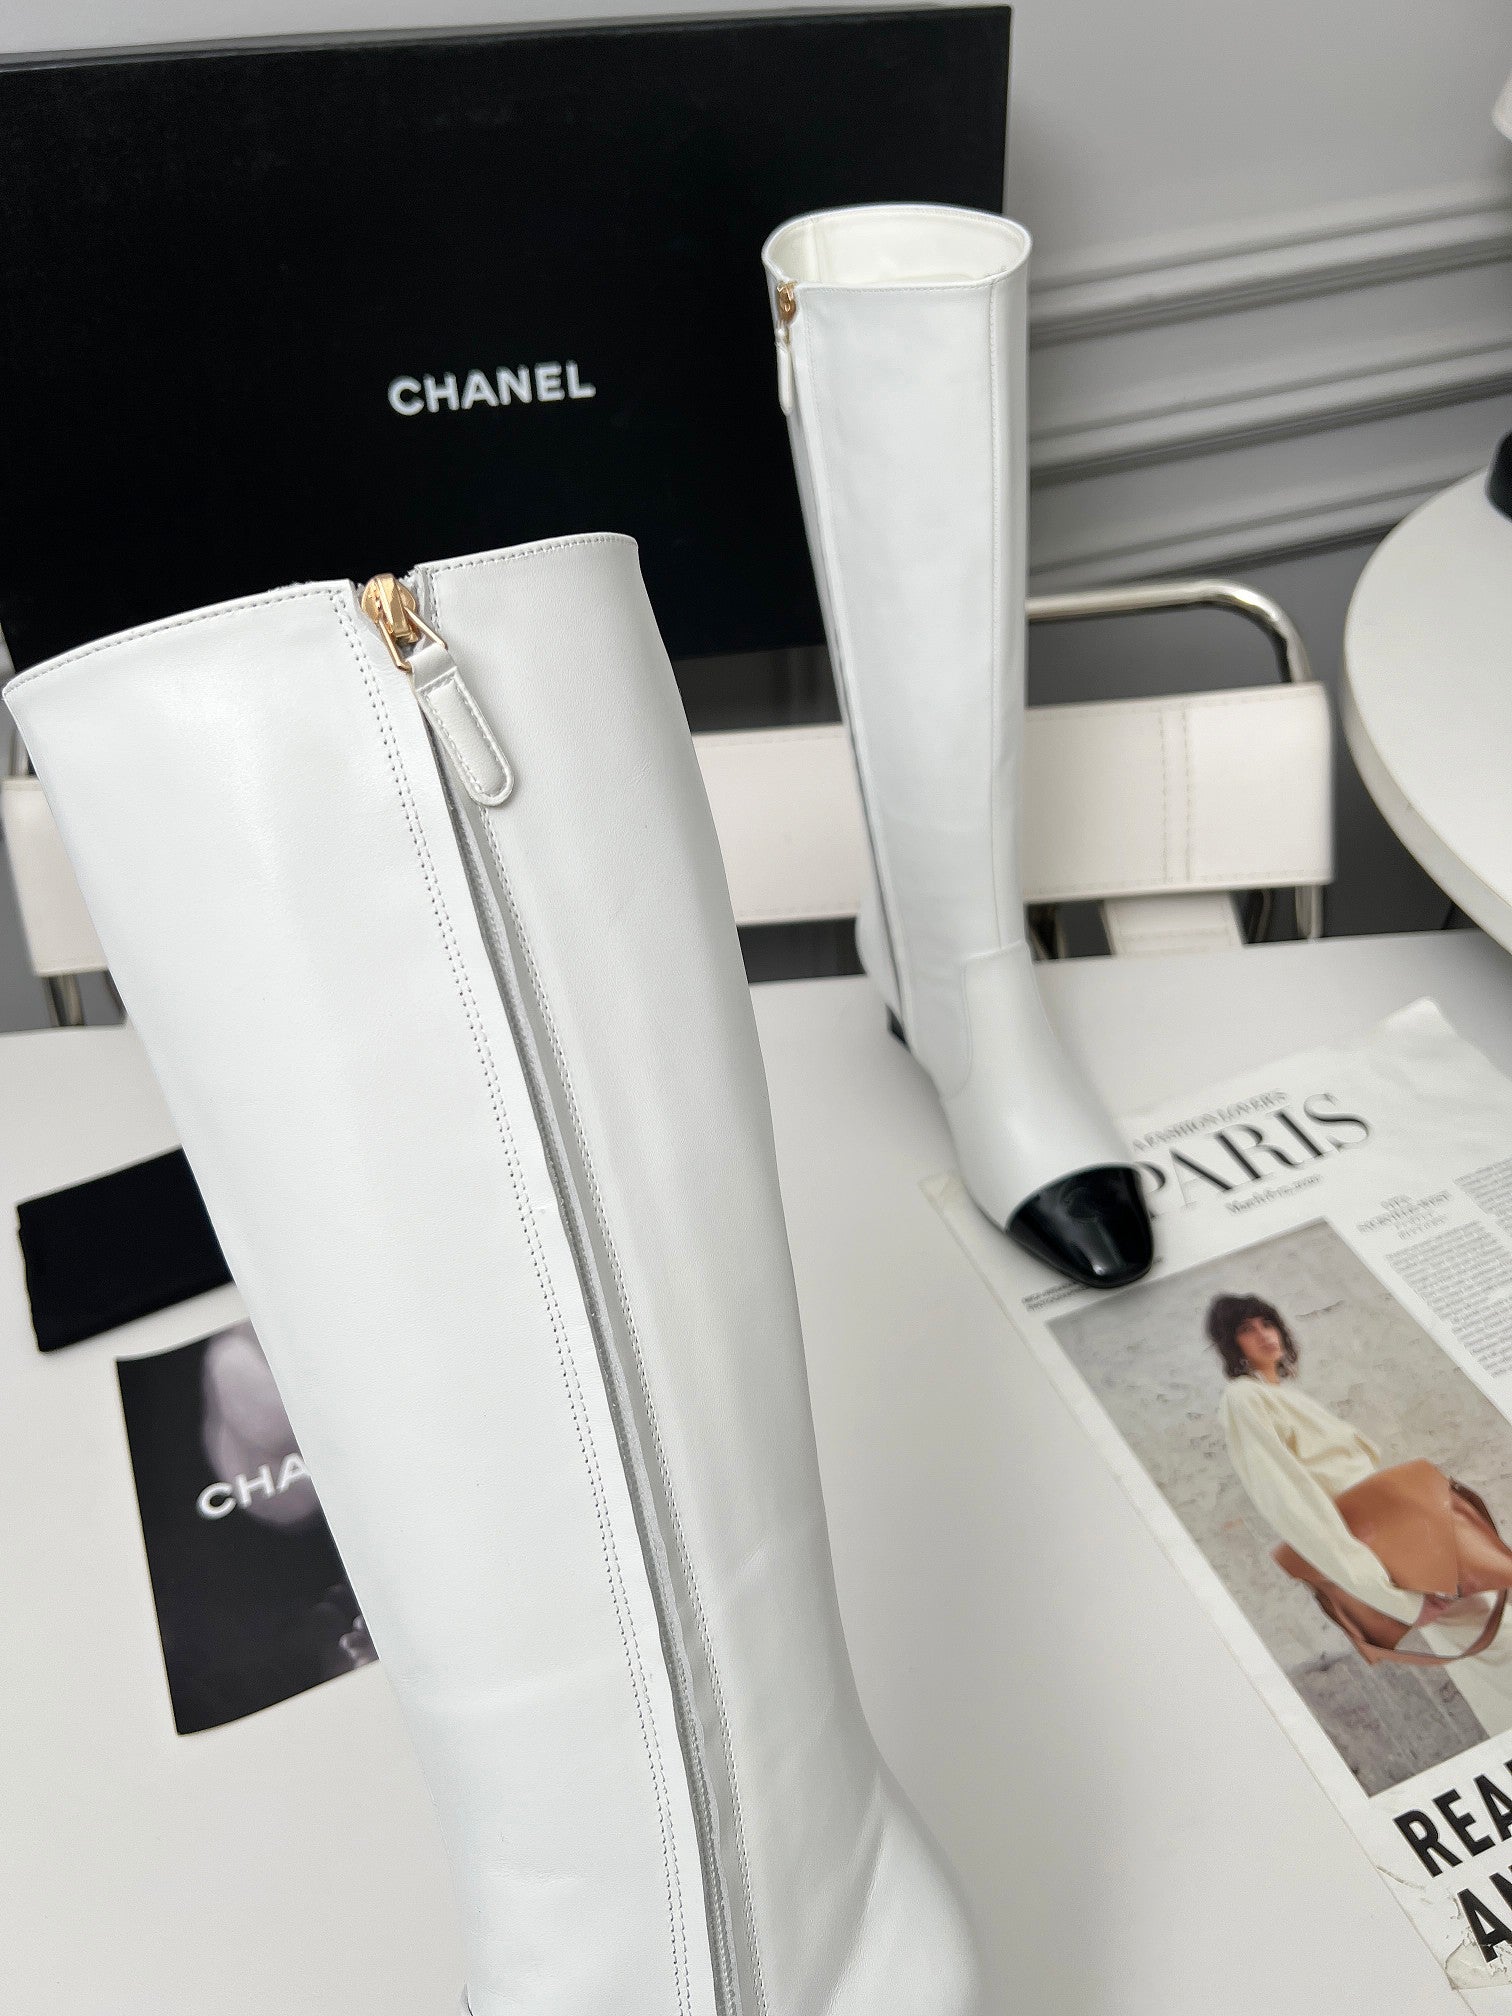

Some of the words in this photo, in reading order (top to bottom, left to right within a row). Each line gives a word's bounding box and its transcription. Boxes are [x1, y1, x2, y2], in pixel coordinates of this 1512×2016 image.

[387, 359, 596, 416] CHANEL
[1135, 1092, 1373, 1220] PARIS
[1144, 1112, 1219, 1146] FASHION
[1392, 1759, 1512, 1878] REA
